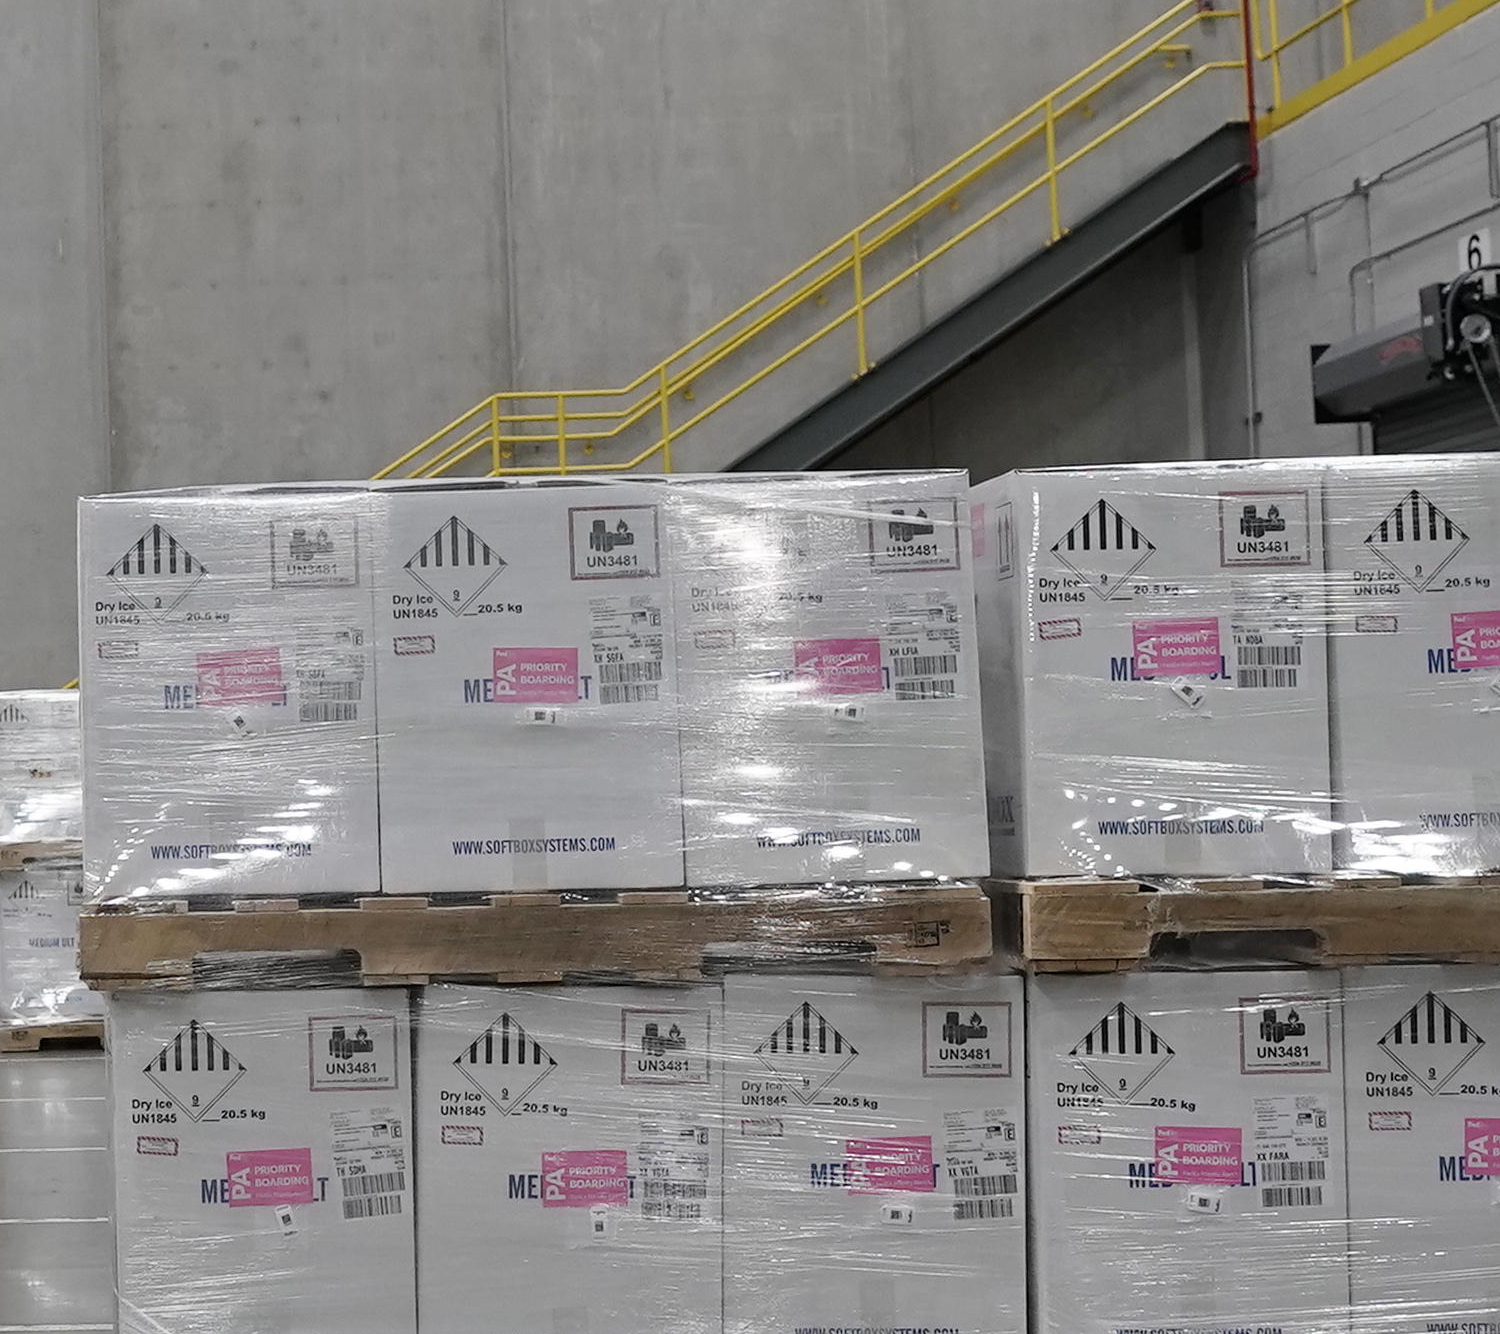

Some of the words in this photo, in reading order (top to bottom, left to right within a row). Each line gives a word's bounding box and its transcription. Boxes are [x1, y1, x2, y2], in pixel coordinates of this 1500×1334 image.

[1468, 234, 1481, 269] 6
[887, 545, 938, 558] UN3481
[1237, 540, 1289, 553] UN3481
[586, 556, 638, 567] UN3481
[1039, 578, 1059, 590] Dry
[1063, 578, 1080, 588] Ice
[393, 595, 412, 607] Dry
[415, 595, 433, 605] Ice
[1039, 591, 1085, 602] UN1845
[393, 608, 438, 618] UN1845
[478, 603, 502, 614] 20.5
[506, 603, 522, 614] kg
[1161, 633, 1209, 644] PRIORITY
[1139, 638, 1158, 669] PA
[1161, 645, 1216, 656] BOARDING
[520, 663, 567, 672] PRIORITY
[497, 664, 516, 695] PA
[520, 675, 574, 685] BOARDING
[453, 836, 615, 853] WWW.SOFTBOXSYSTEMS.COM
[939, 1048, 990, 1061] UN3481
[1257, 1046, 1309, 1058] UN3481
[326, 1062, 377, 1075] UN3481
[638, 1060, 689, 1072] UN3481
[1366, 1072, 1387, 1084] Dry
[1390, 1072, 1408, 1082] Ice
[1367, 1086, 1413, 1097] UN1845
[1461, 1085, 1486, 1096] 20.5
[132, 1099, 152, 1111] Dry
[156, 1099, 172, 1109] Ice
[132, 1113, 177, 1124] UN1845
[221, 1110, 247, 1119] 20.5
[250, 1109, 265, 1120] kg
[1467, 1135, 1488, 1168] PA
[254, 1164, 301, 1175] PRIORITY
[231, 1168, 251, 1200] PA
[255, 1177, 308, 1187] BOARDING
